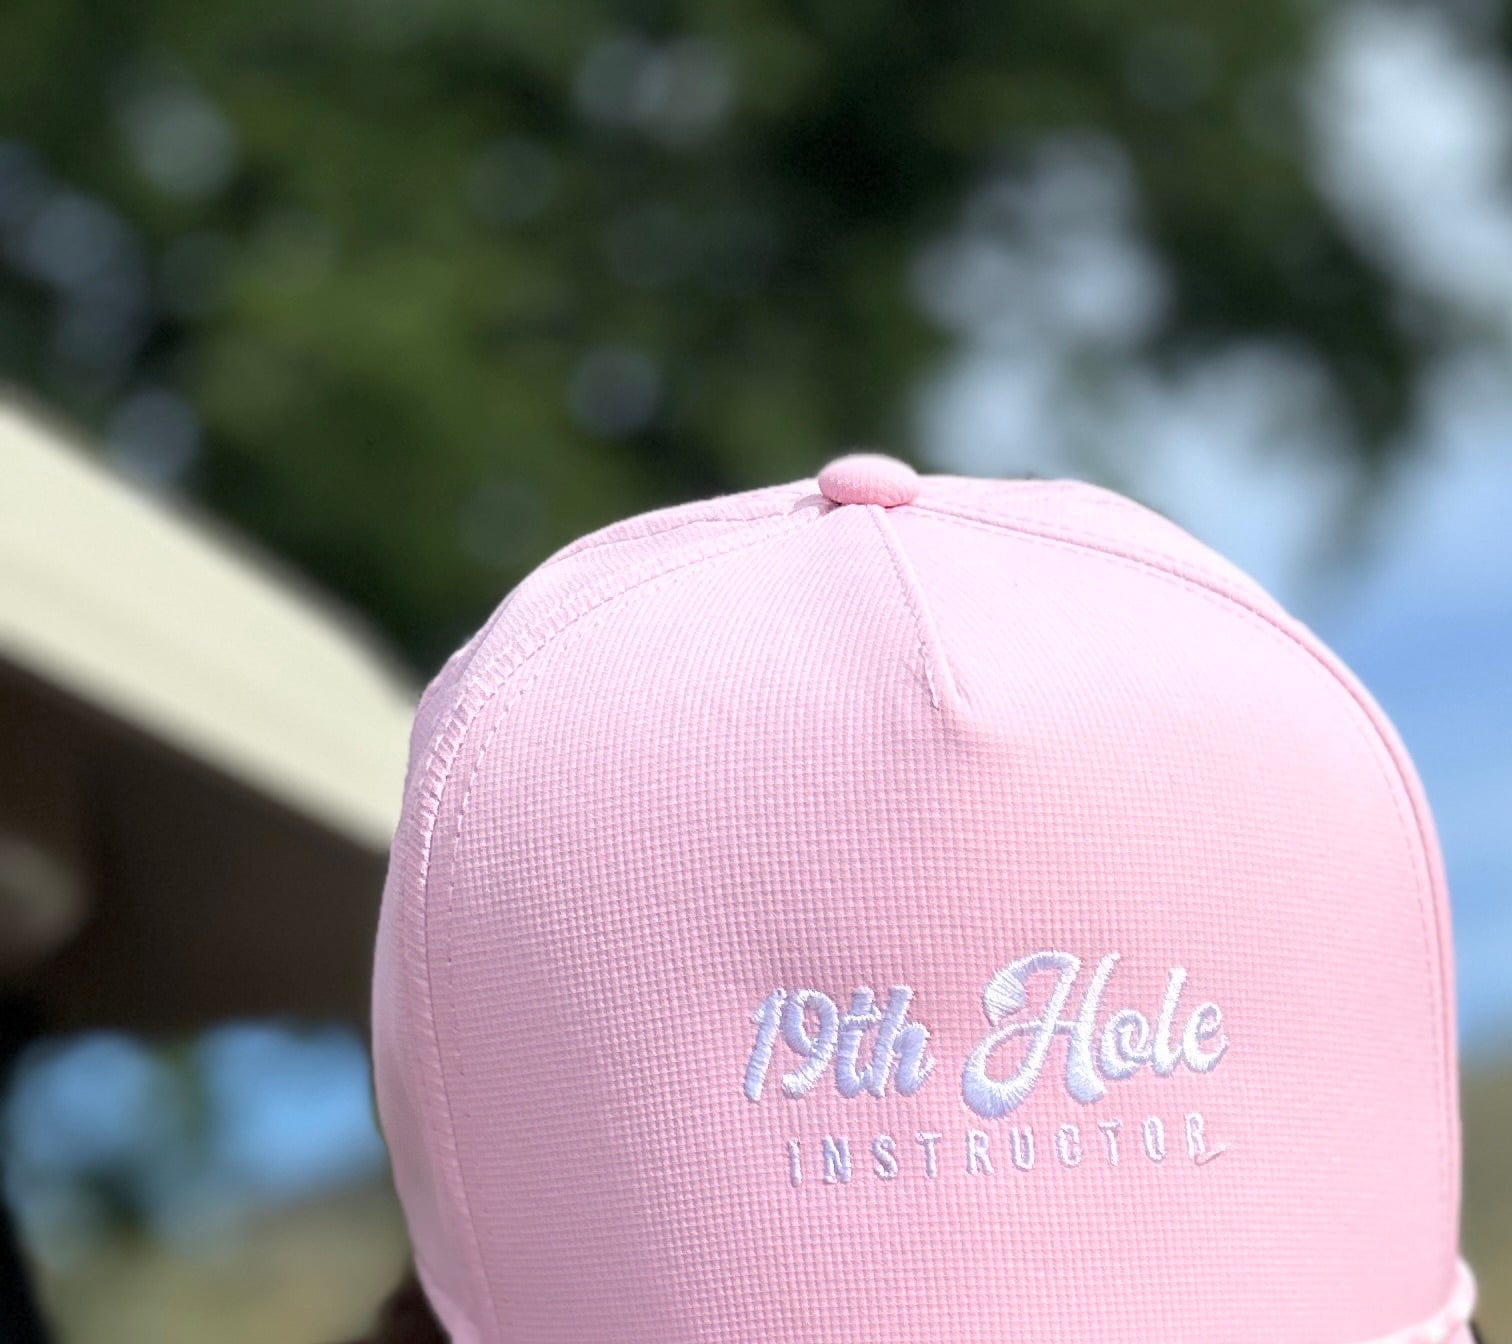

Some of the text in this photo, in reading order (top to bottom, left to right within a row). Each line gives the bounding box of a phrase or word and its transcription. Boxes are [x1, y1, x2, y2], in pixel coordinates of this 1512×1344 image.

[743, 949, 1229, 1119] 19th Hole
[788, 1111, 1231, 1187] INSTRUCTOR
